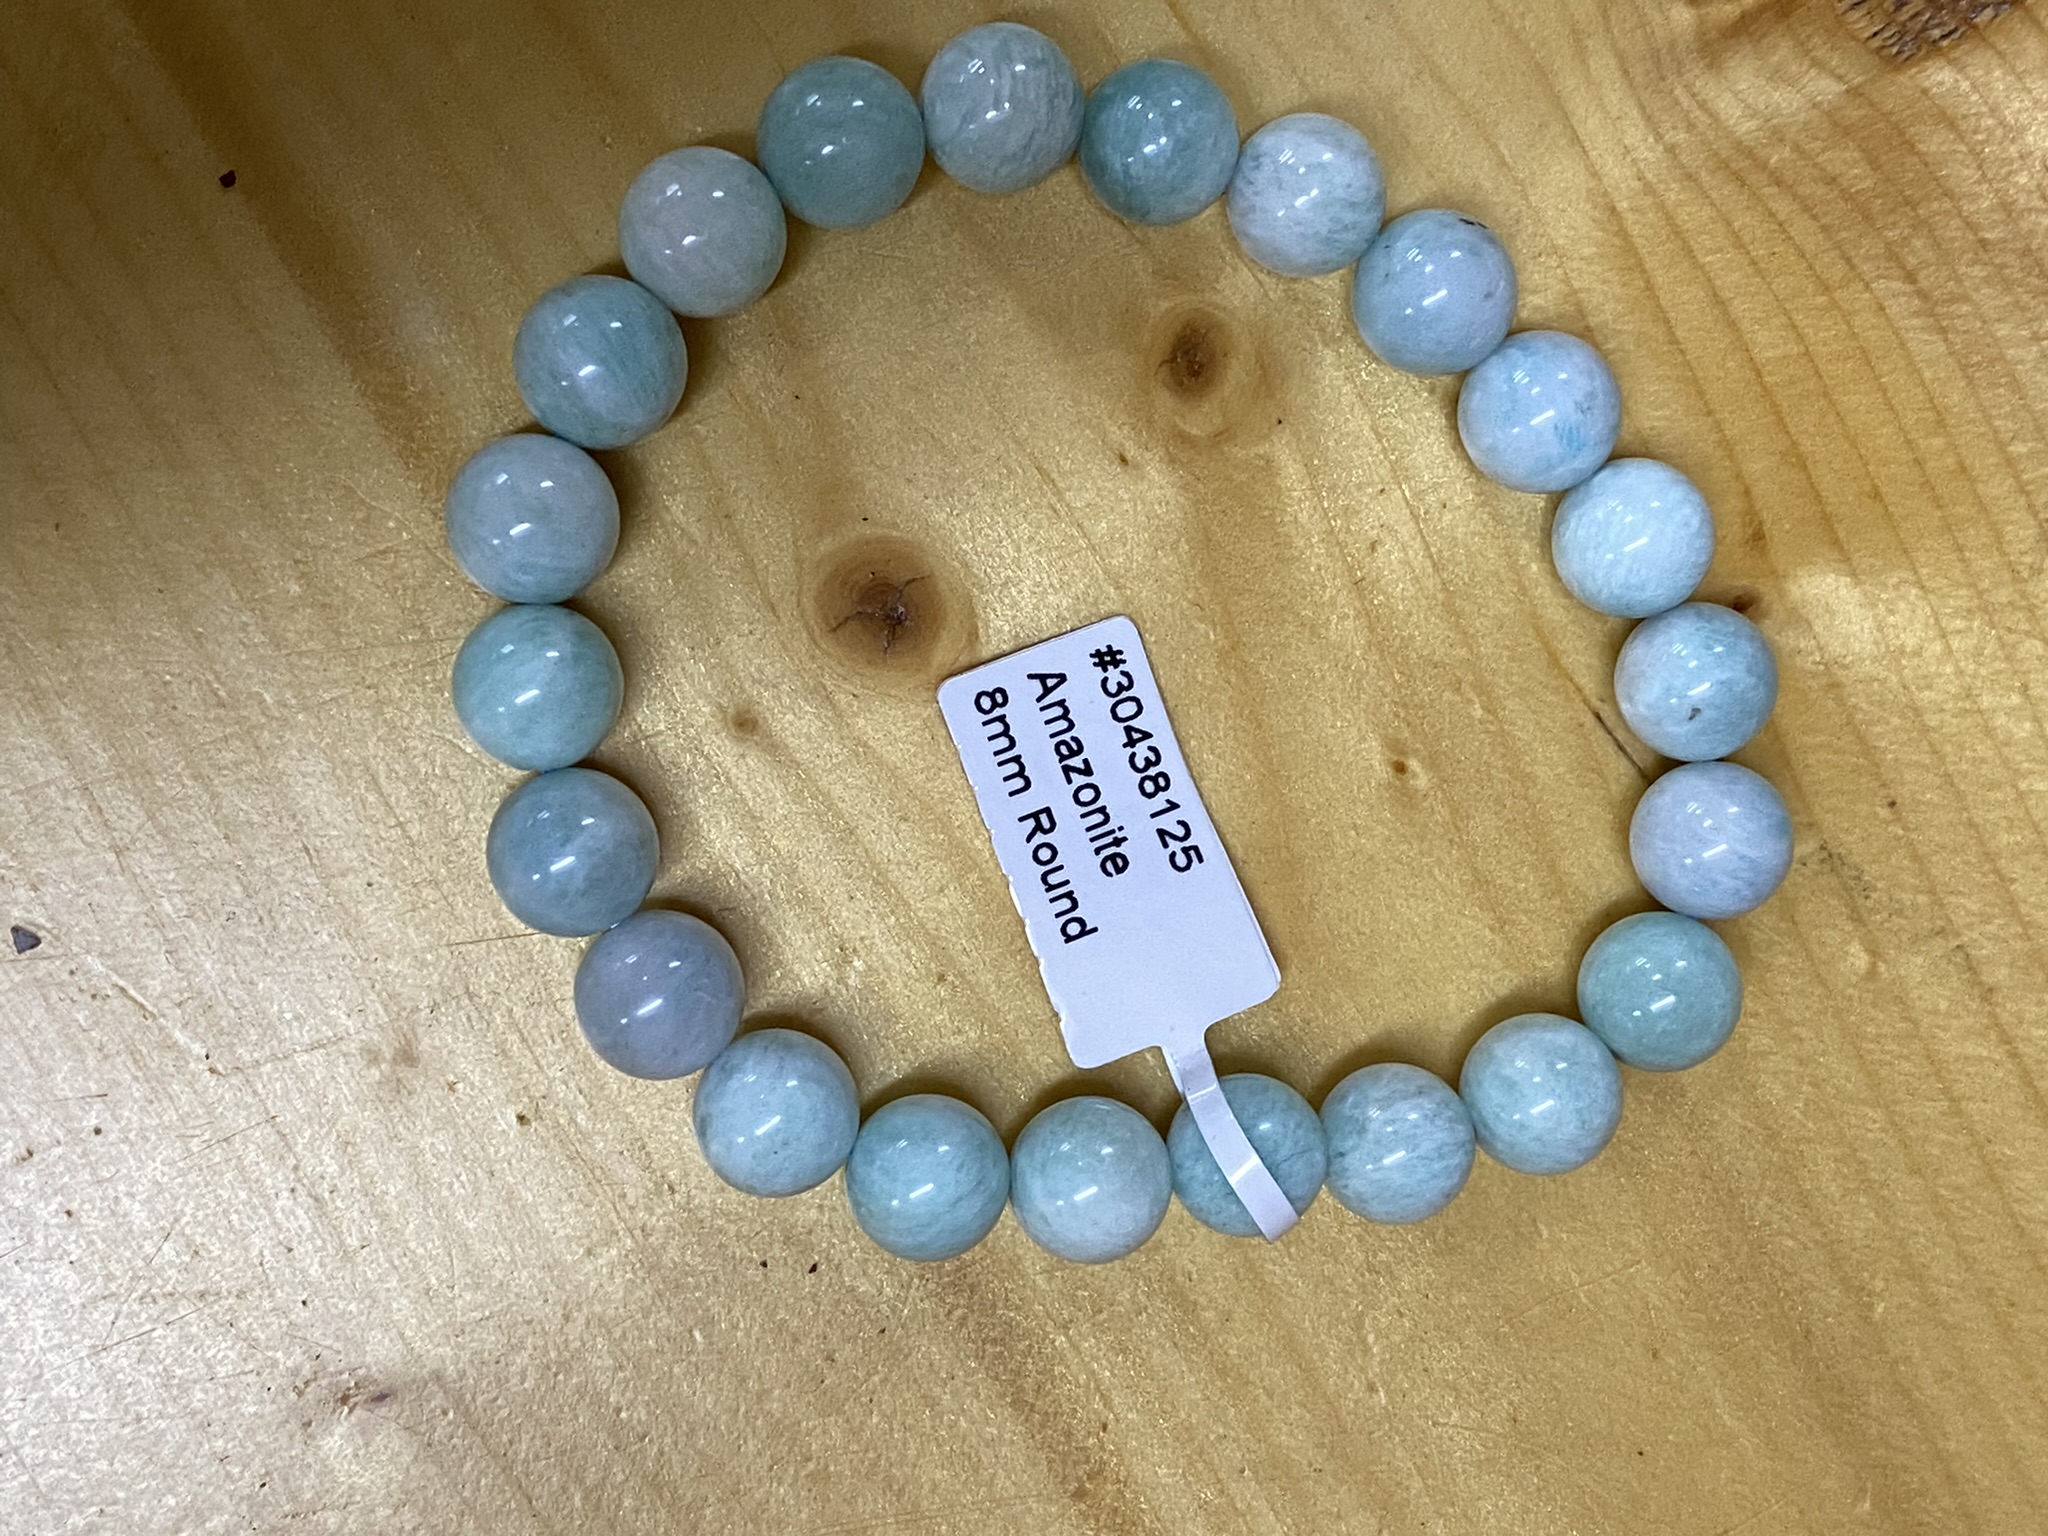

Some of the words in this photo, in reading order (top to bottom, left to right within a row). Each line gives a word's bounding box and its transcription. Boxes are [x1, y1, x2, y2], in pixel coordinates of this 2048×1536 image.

[973, 686, 1032, 798] 8mm
[1017, 806, 1099, 944] Round
[1026, 672, 1130, 878] Amazonite
[1089, 644, 1205, 873] #30438125
